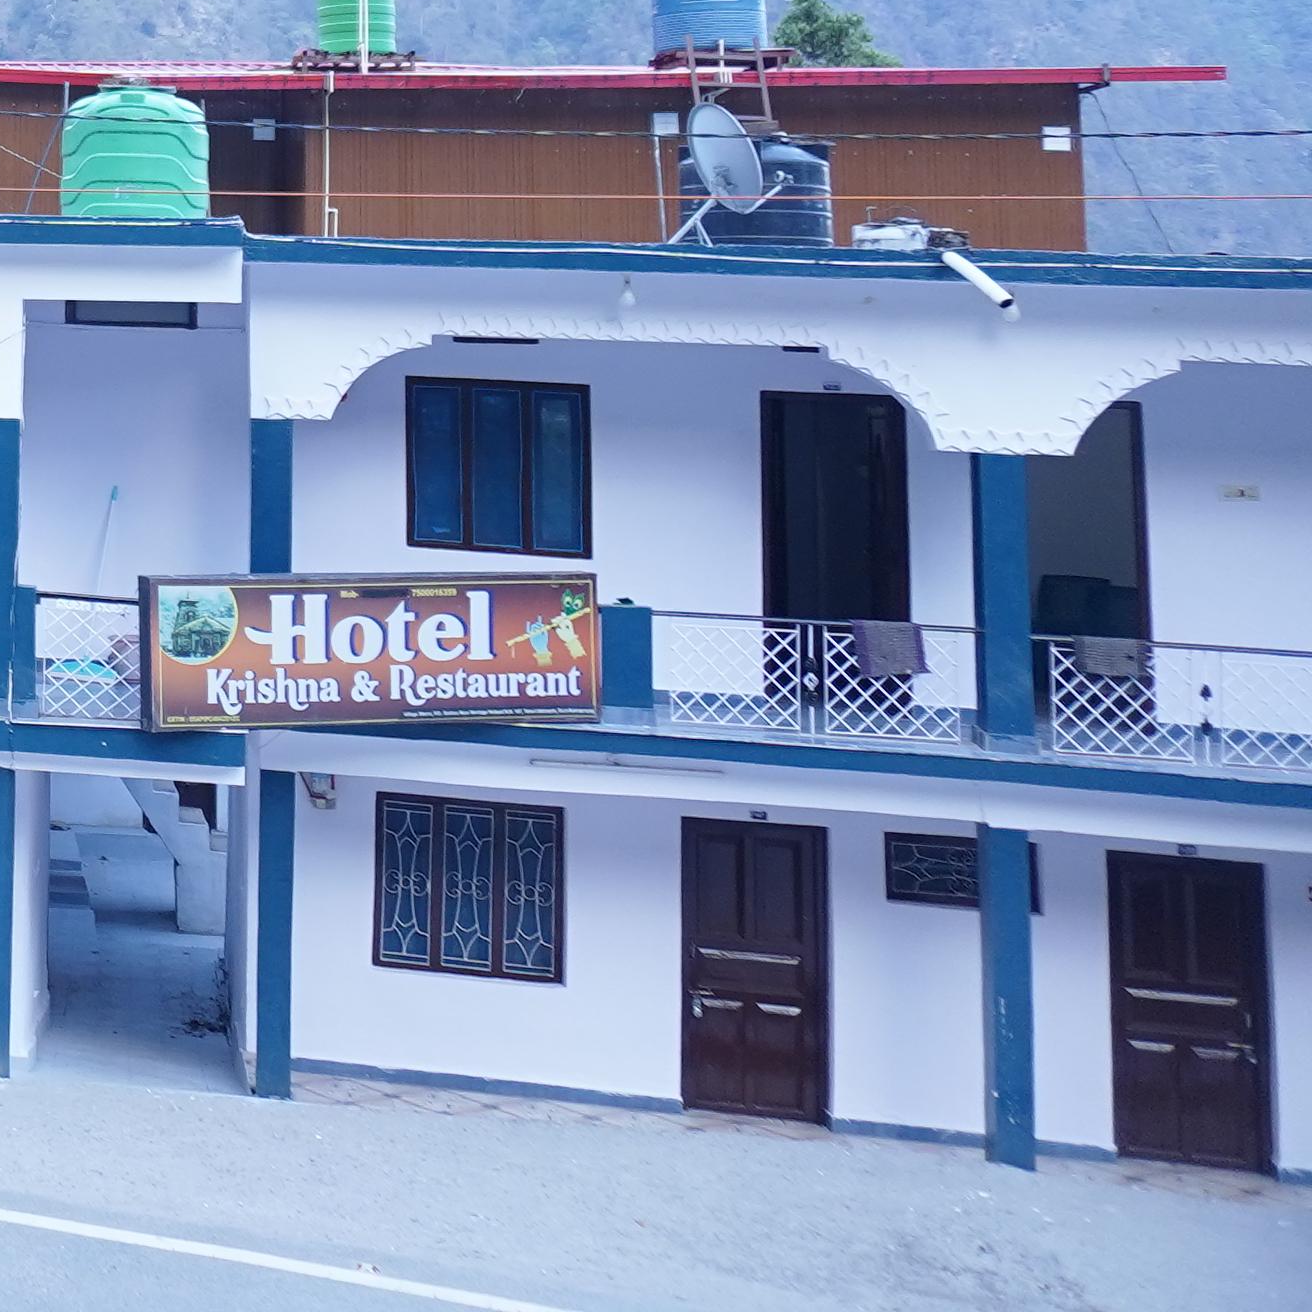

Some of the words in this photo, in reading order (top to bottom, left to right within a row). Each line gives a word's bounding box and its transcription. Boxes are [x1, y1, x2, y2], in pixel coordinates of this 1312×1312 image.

[244, 590, 495, 665] Hotel
[206, 665, 340, 715] Krishna
[351, 670, 380, 702] &
[390, 664, 582, 706] Restaurant
